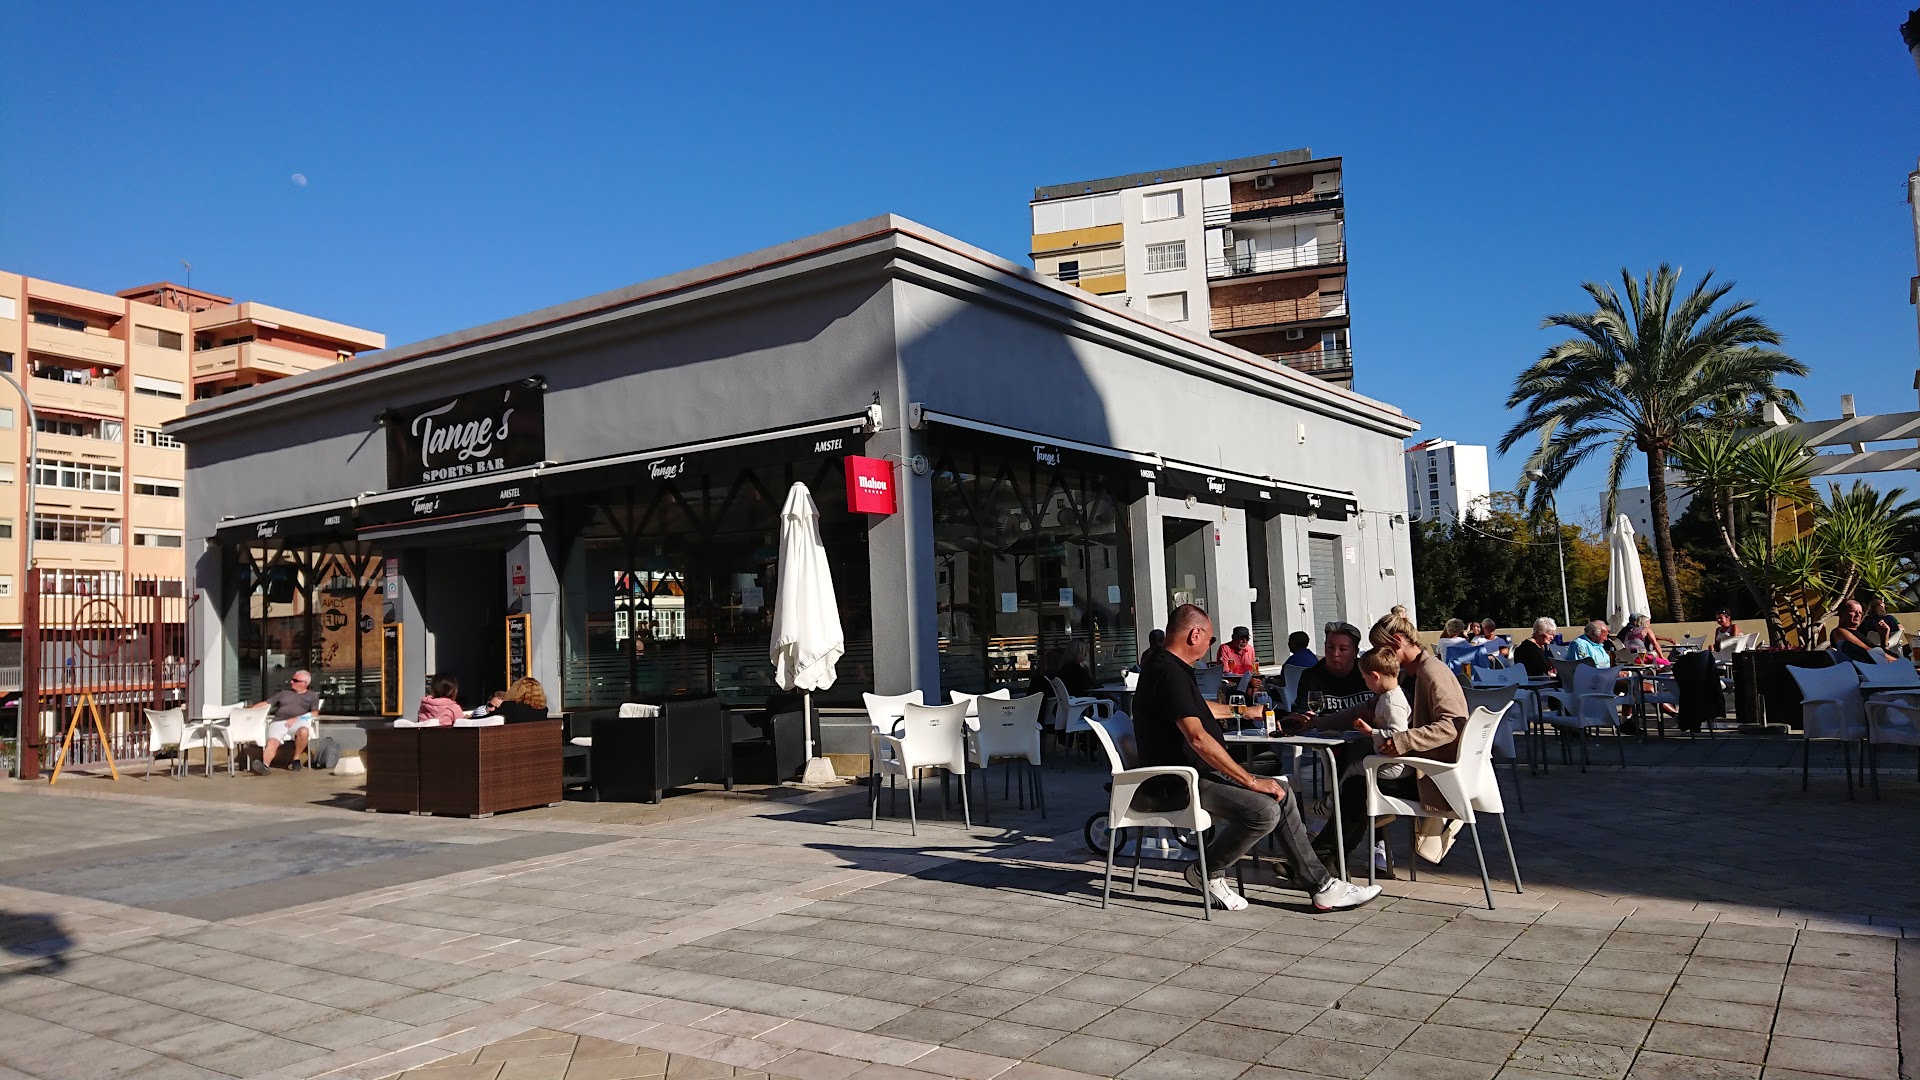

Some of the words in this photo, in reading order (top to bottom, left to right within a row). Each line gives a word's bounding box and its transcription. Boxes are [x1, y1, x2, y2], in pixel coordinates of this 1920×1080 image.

[411, 389, 515, 468] Tange's
[814, 439, 843, 452] AMSTEL
[1033, 446, 1060, 465] Tange's
[422, 464, 473, 482] SPORTS
[477, 458, 504, 472] BAR
[648, 457, 685, 480] Tange's
[859, 476, 887, 490] Mahou
[500, 488, 521, 500] AMSTEL
[412, 495, 440, 514] Tange's
